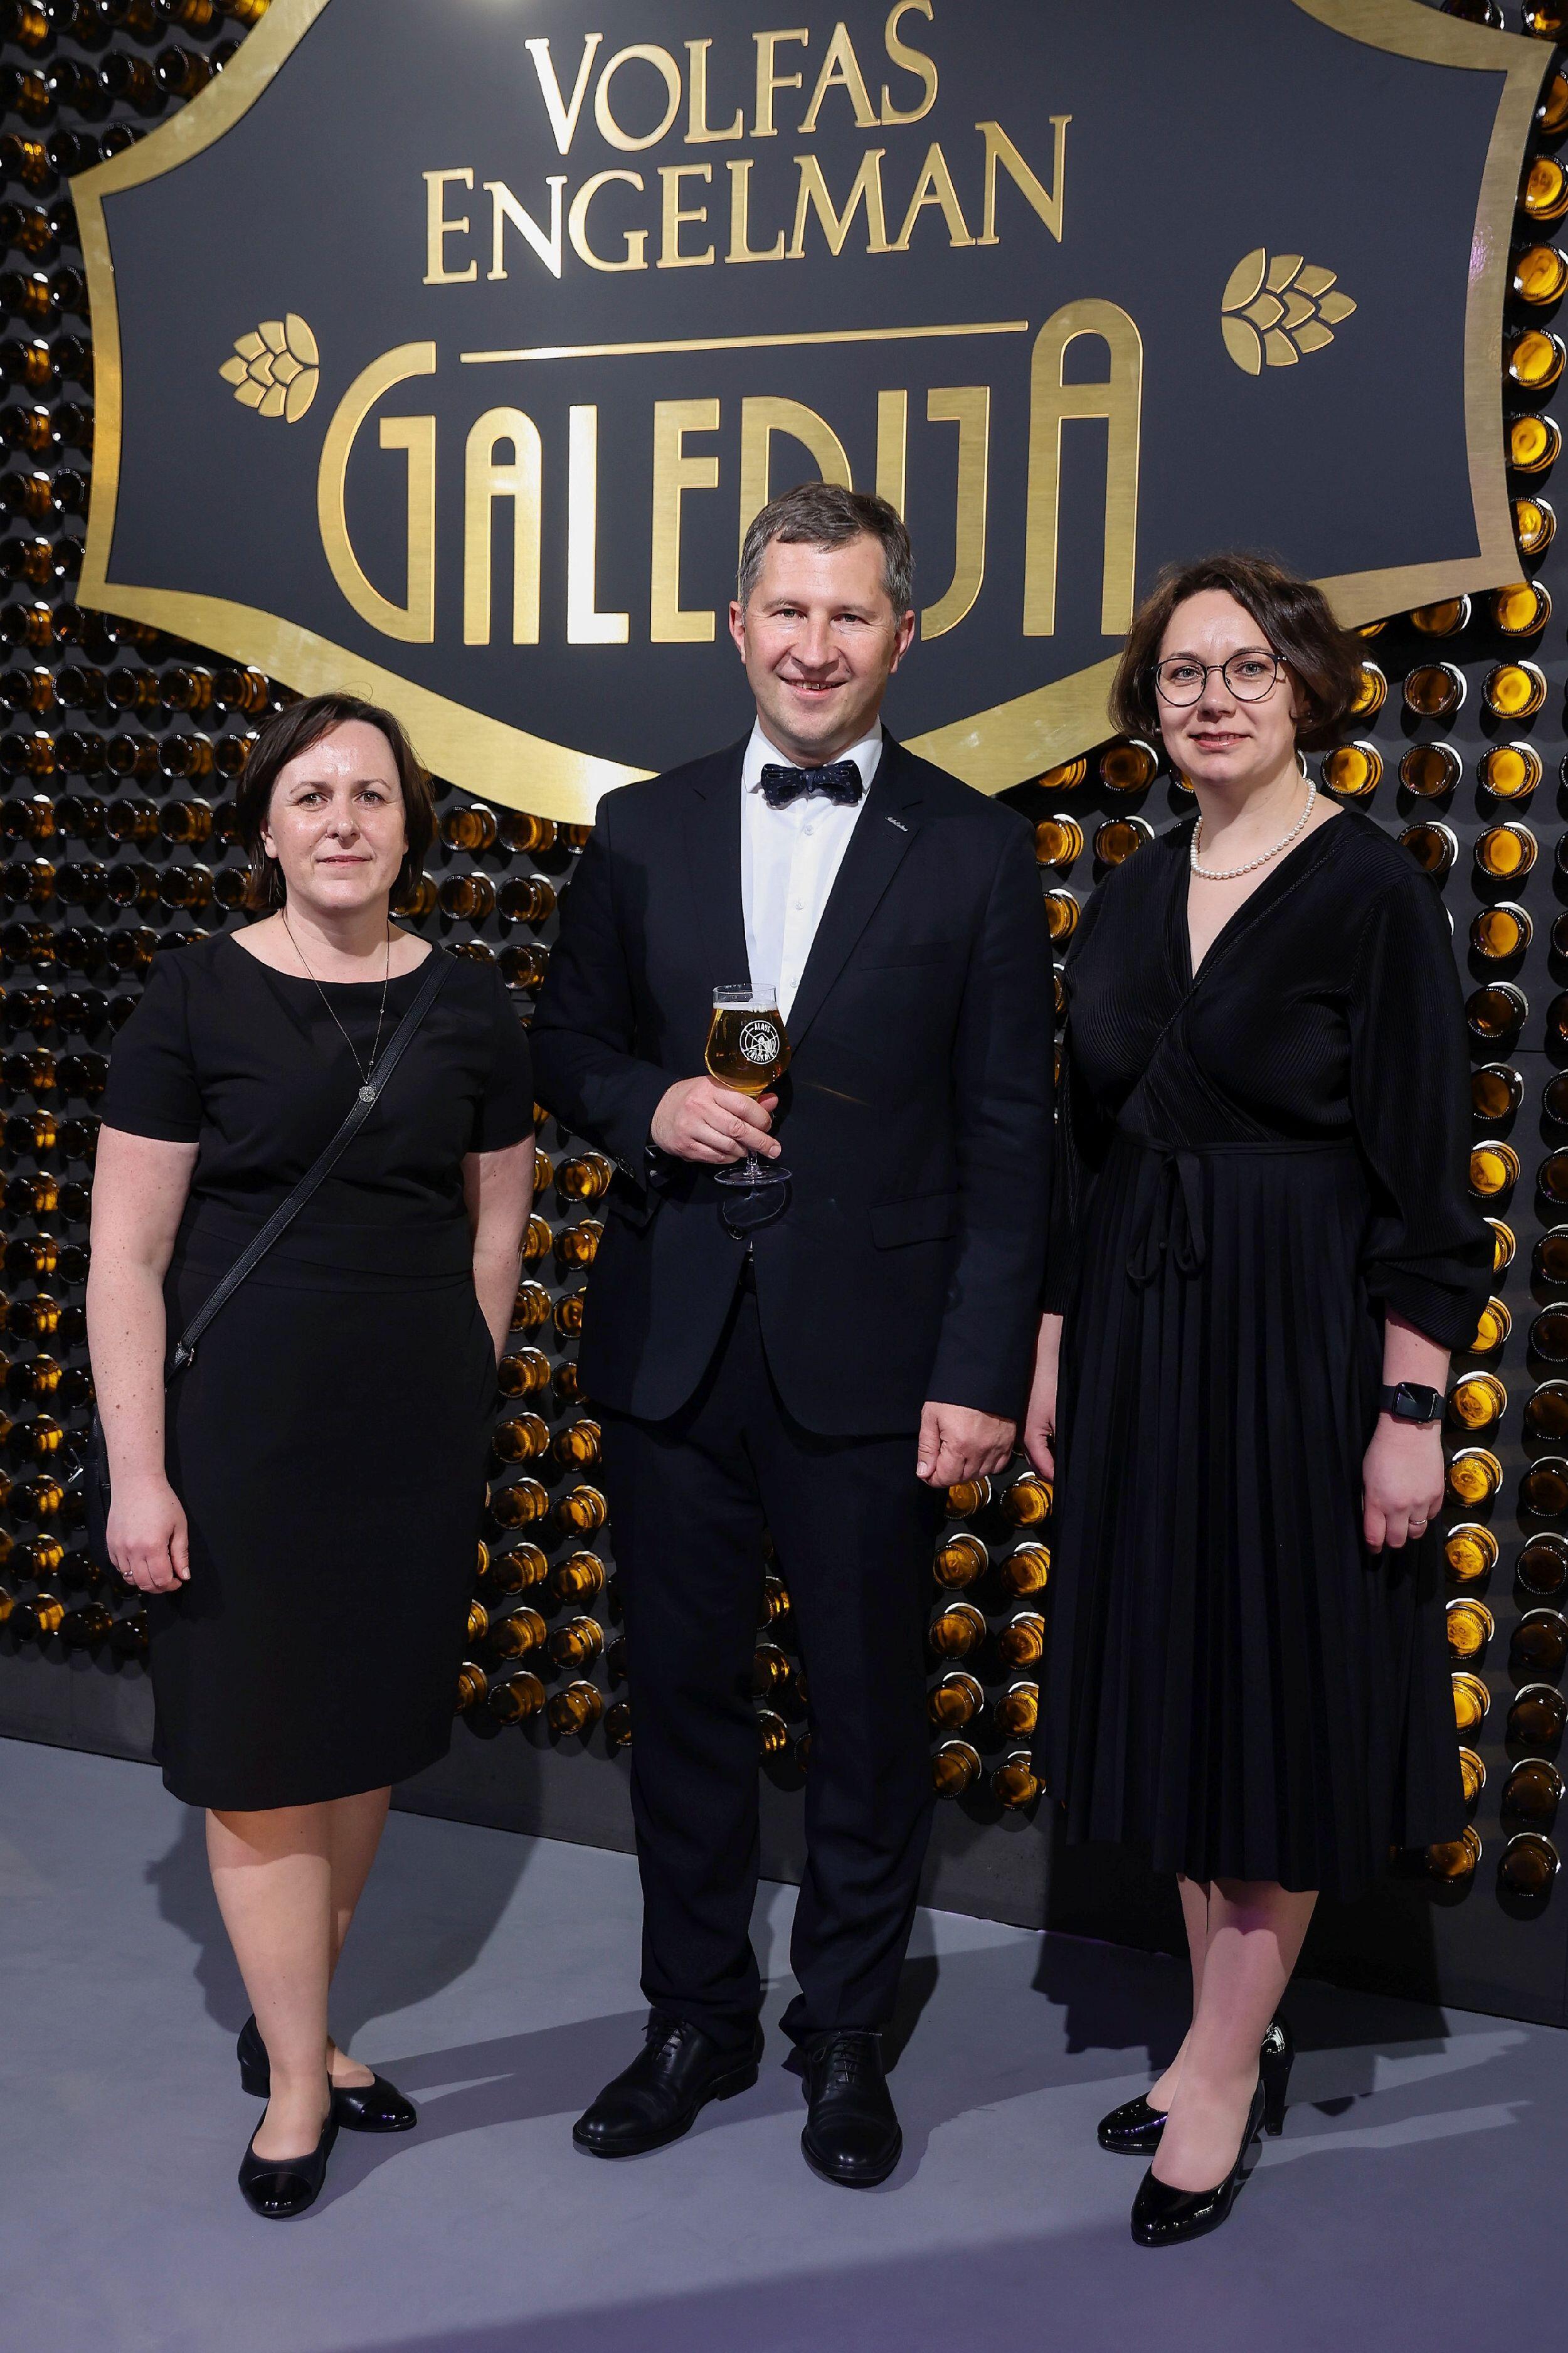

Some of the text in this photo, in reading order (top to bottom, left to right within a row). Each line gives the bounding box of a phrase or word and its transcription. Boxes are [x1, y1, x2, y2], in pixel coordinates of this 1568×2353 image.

[525, 0, 939, 155] VOLFAS
[422, 114, 1072, 285] ENGELMAN
[755, 1022, 771, 1033] ALAUS
